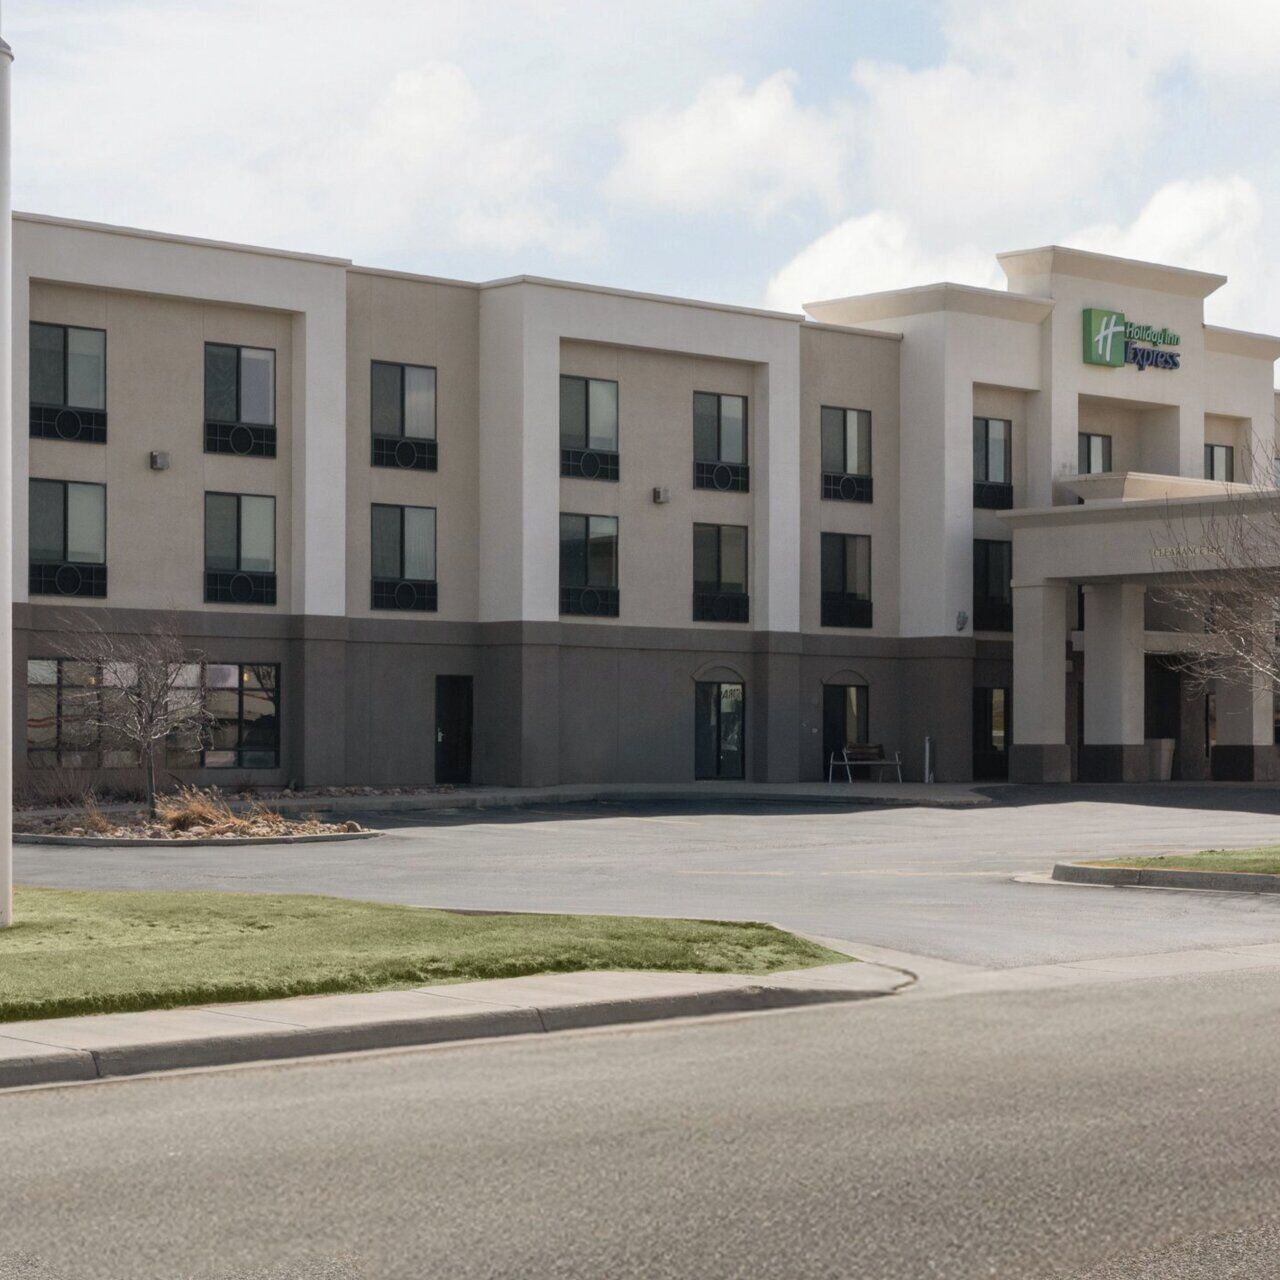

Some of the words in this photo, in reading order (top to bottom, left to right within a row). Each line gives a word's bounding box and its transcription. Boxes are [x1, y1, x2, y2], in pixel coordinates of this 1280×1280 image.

[1125, 322, 1163, 346] Holiday
[1162, 328, 1181, 346] Inn
[1125, 341, 1181, 370] Express
